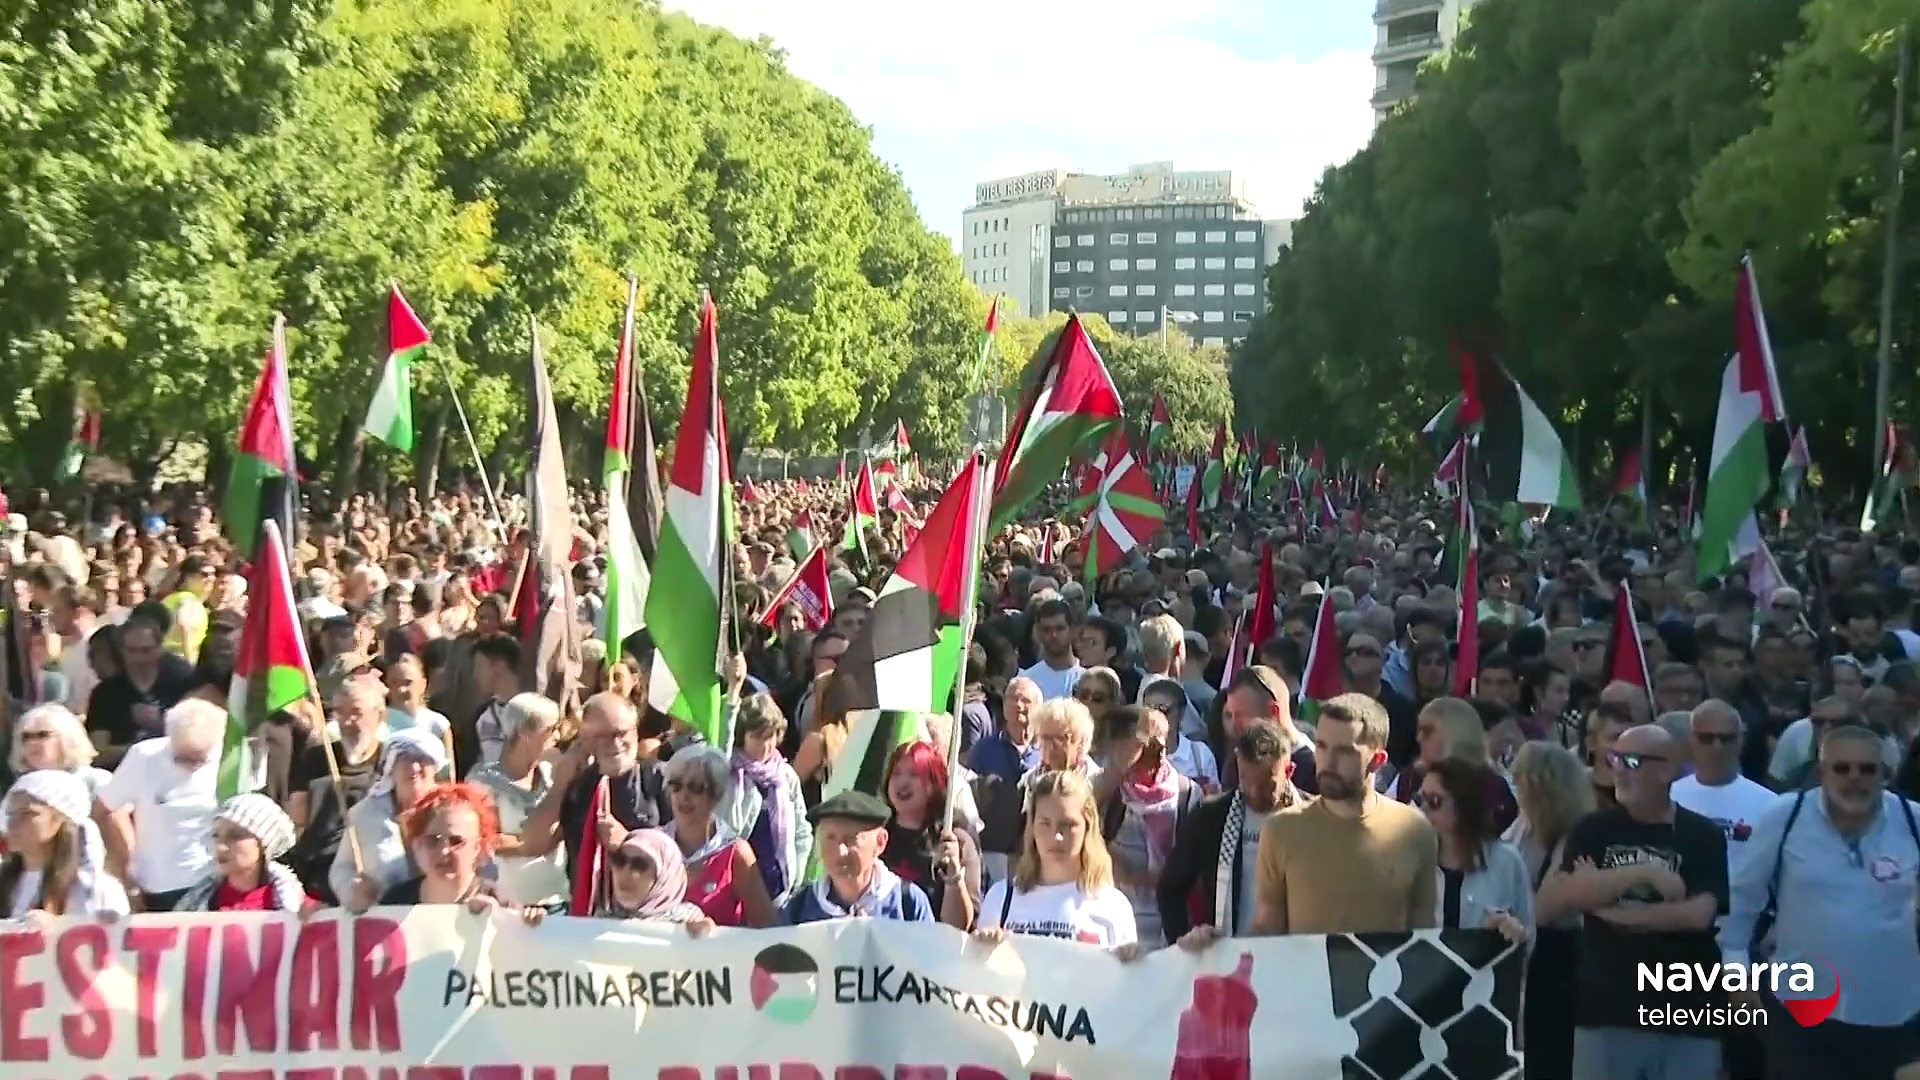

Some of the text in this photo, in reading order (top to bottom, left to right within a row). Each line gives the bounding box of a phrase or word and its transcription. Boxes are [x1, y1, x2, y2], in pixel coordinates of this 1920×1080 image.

[976, 172, 1055, 201] HOTEL TRES REYES
[1161, 174, 1224, 192] HOTEL
[0, 917, 407, 1062] ESTINAR
[443, 964, 1096, 1046] PALESTINAREKIN ELKARTASUNA
